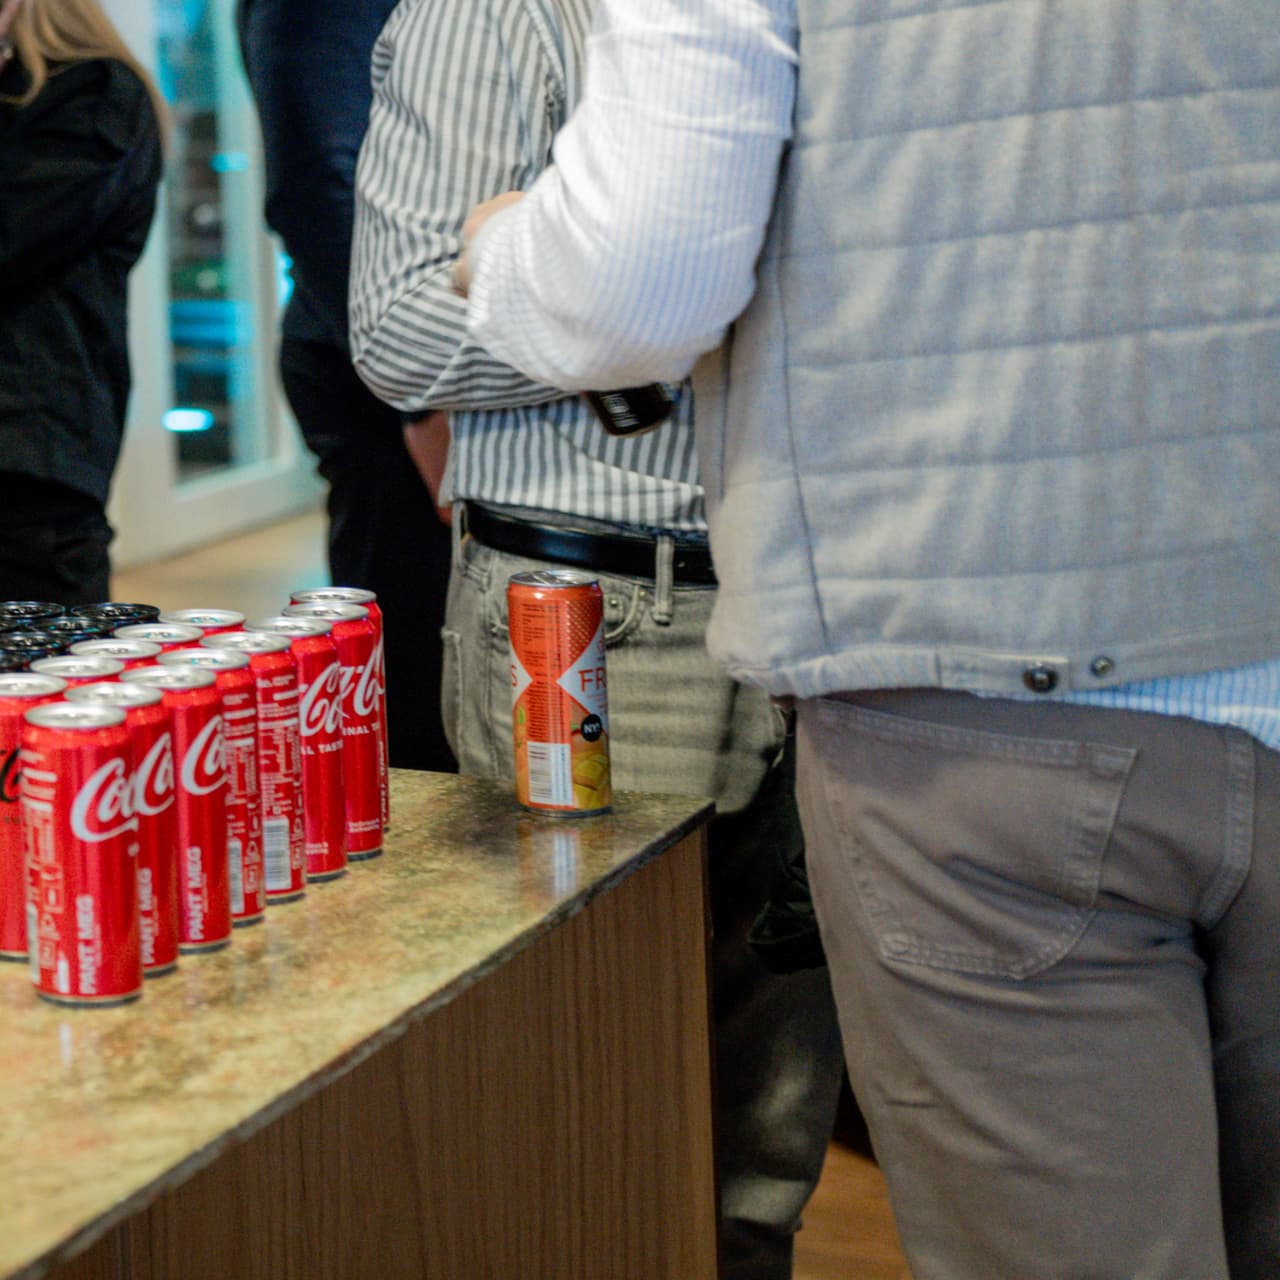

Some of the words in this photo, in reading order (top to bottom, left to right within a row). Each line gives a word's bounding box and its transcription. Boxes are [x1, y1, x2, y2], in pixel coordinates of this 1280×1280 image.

[139, 868, 152, 911] MEG
[187, 846, 202, 888] MEG
[76, 896, 93, 939] MEG
[187, 893, 204, 940] PANT
[141, 916, 155, 964] PANT
[78, 942, 97, 994] PANT
